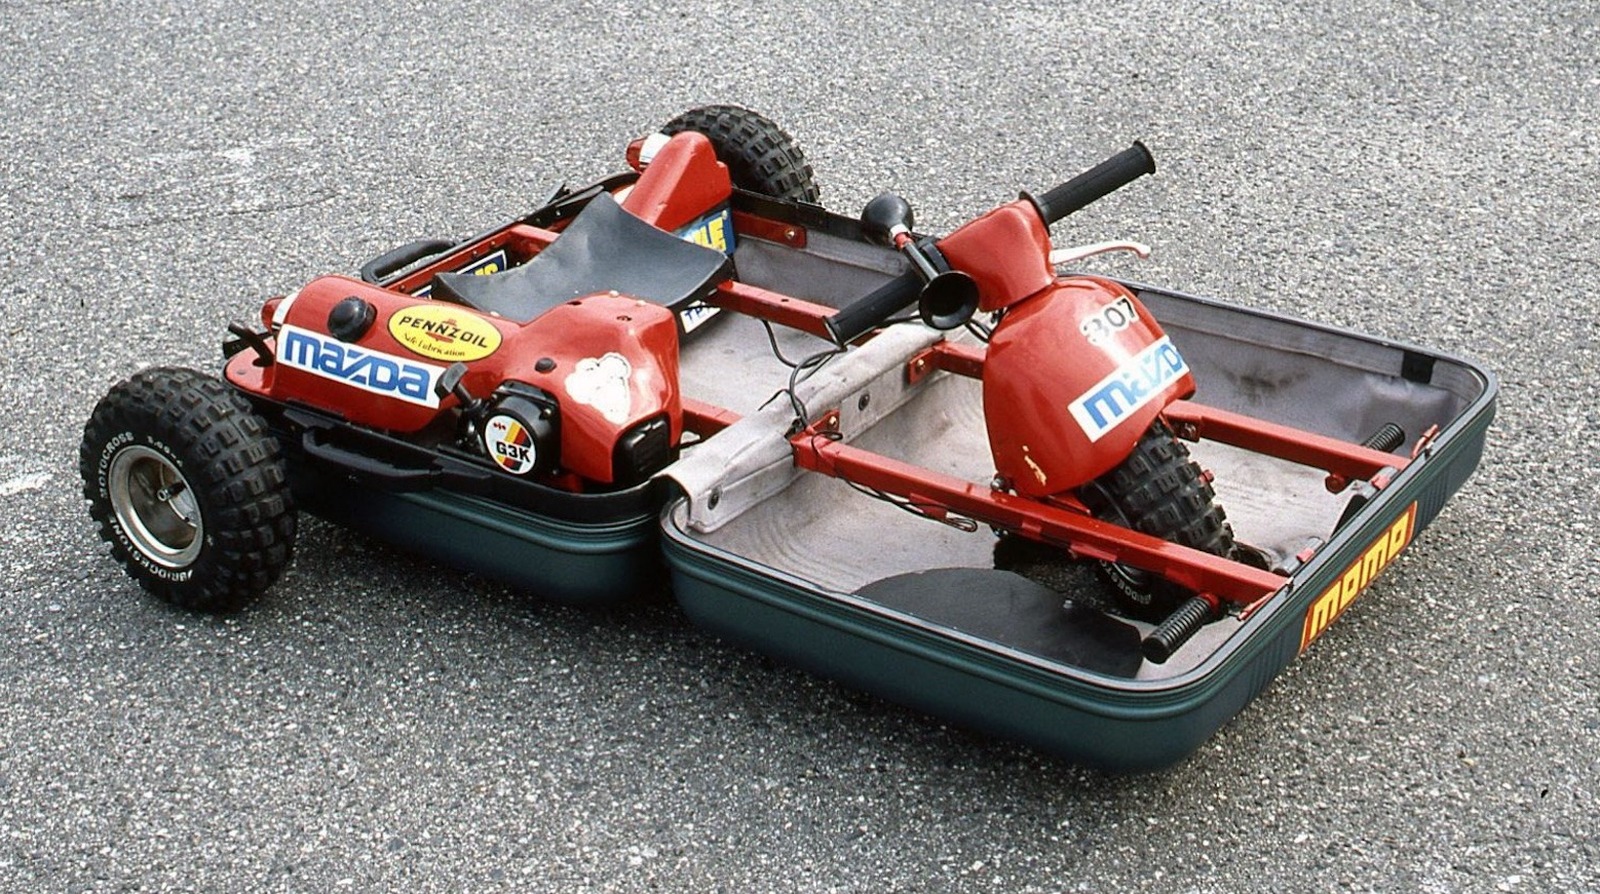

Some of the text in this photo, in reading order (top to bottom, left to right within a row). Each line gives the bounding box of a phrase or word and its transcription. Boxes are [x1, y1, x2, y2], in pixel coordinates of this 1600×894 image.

[398, 315, 488, 348] PENNZOIL
[284, 330, 431, 401] mazda
[98, 431, 135, 499] MOTOCROSS
[496, 440, 531, 463] G3K
